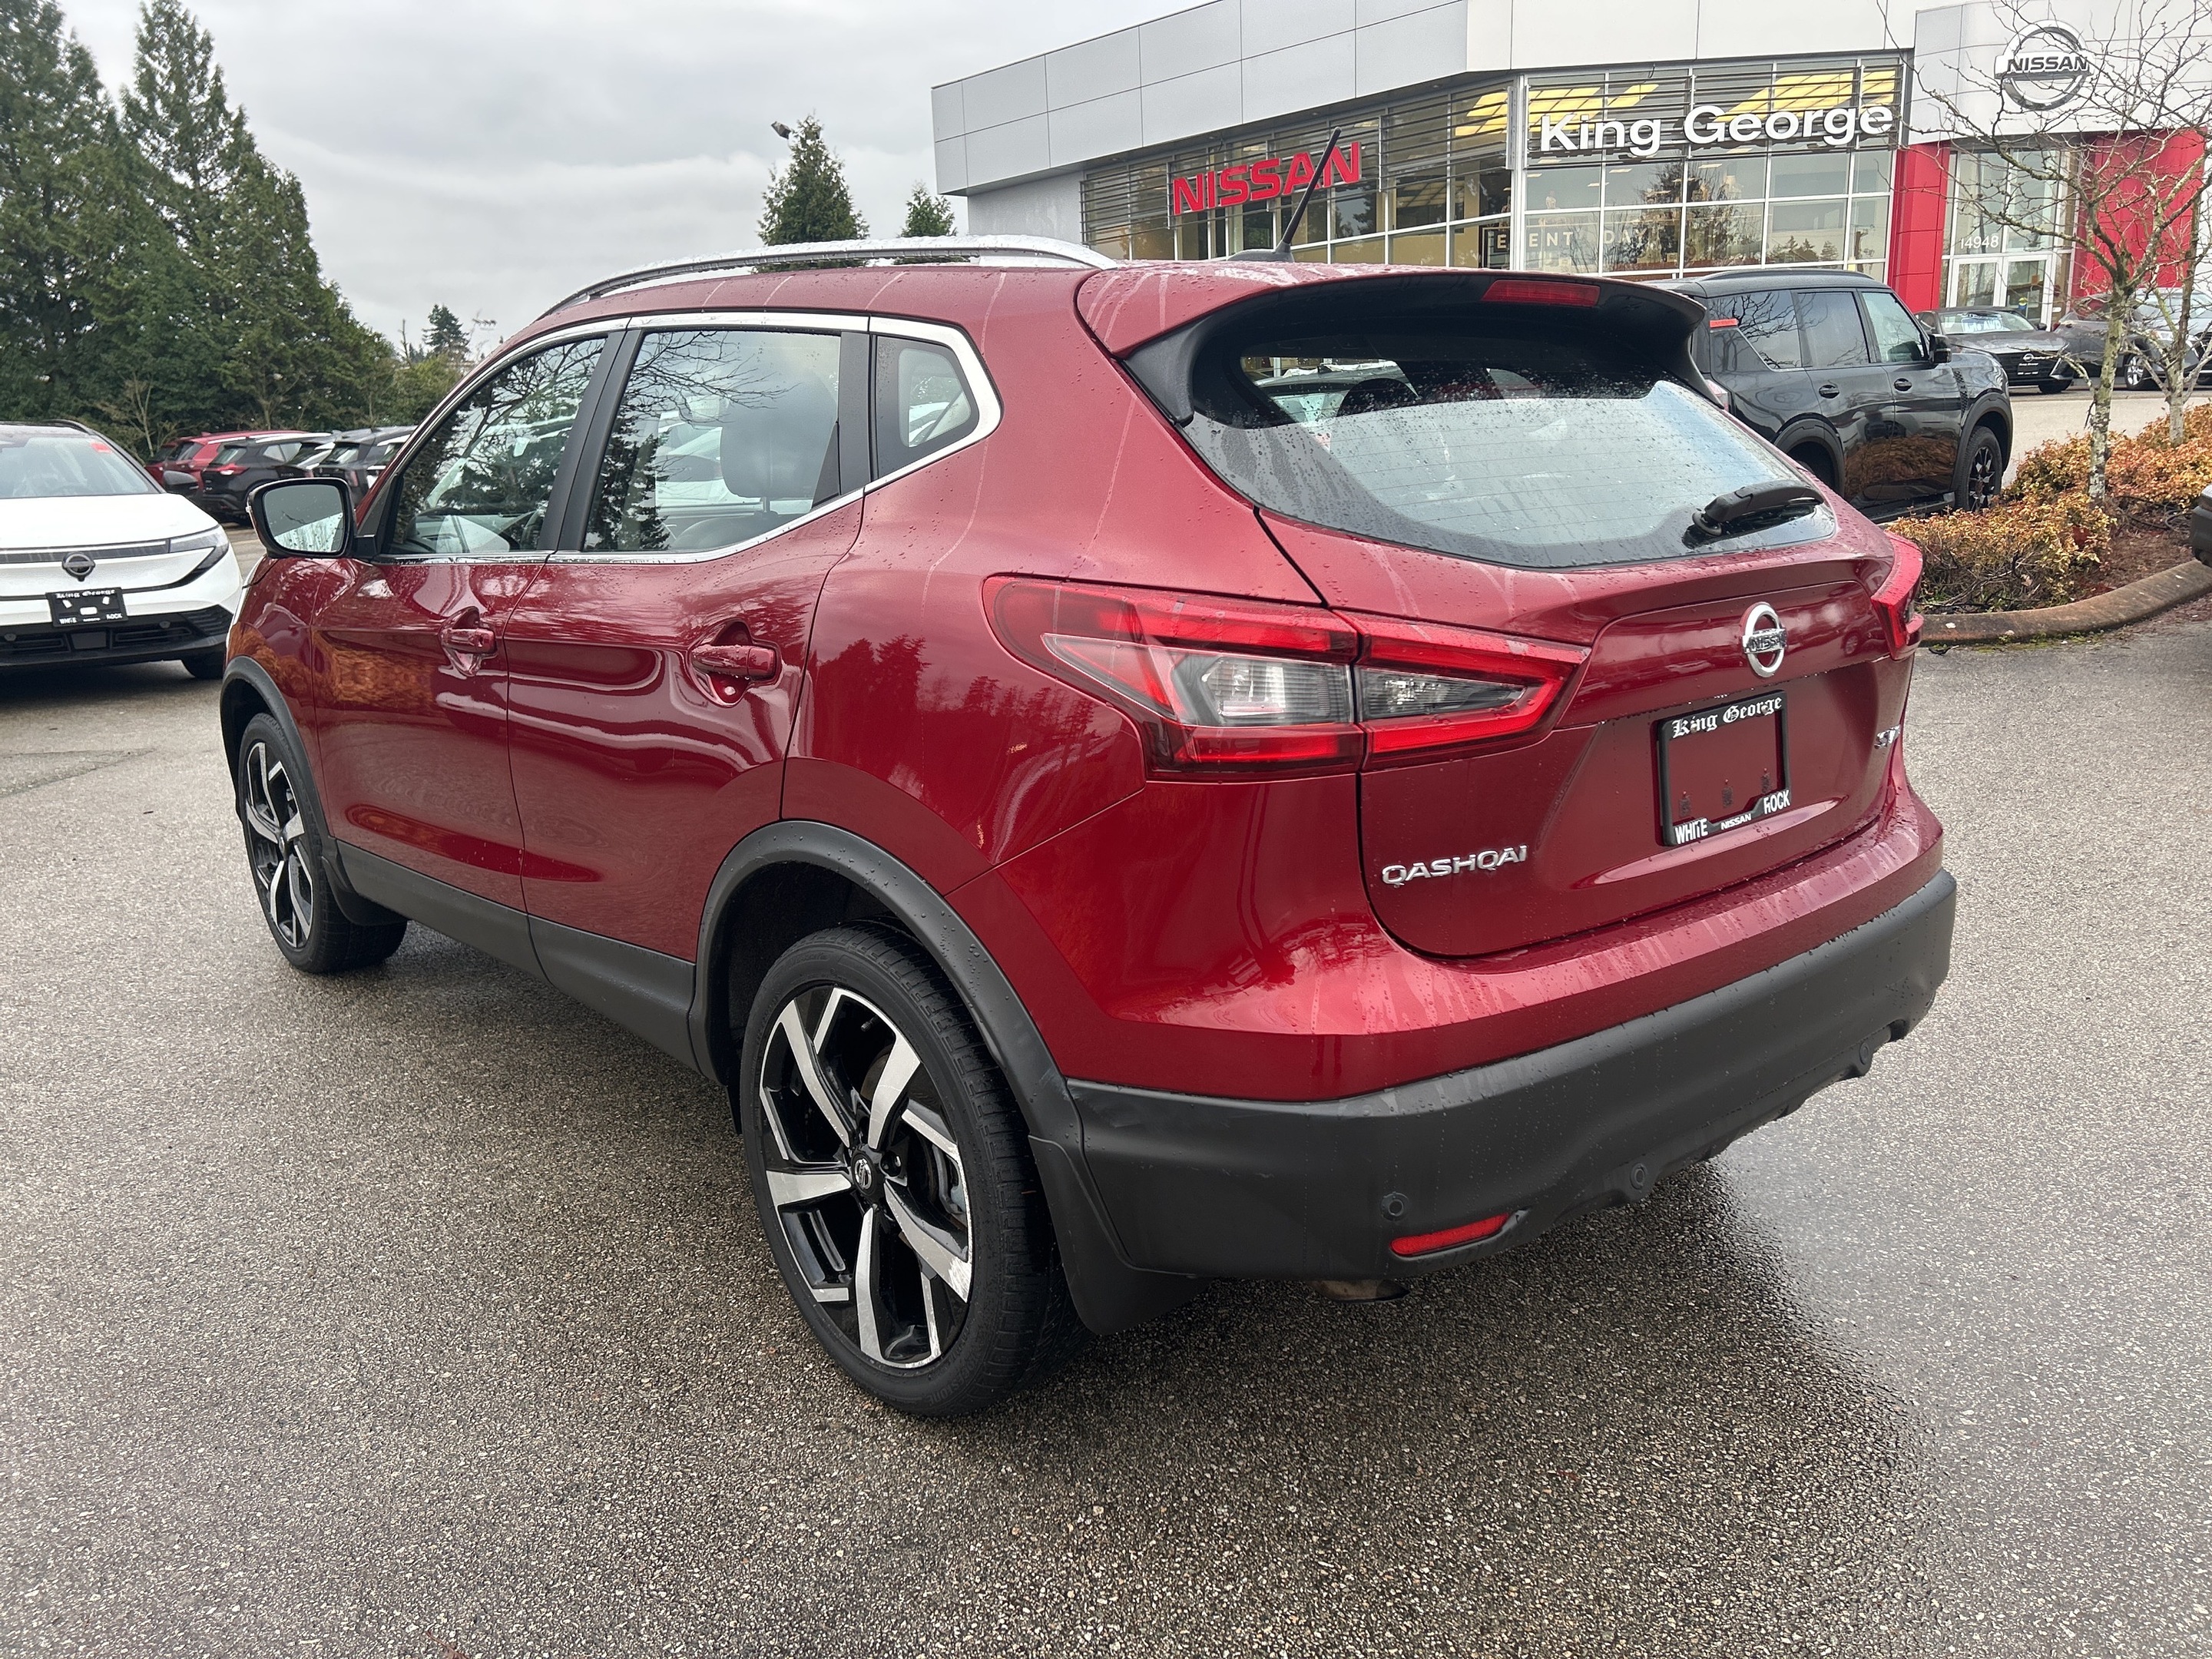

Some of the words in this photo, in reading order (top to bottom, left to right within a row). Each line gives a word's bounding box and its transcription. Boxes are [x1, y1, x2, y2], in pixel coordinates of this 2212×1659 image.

[2007, 56, 2088, 74] NISSAN
[1540, 113, 1661, 157] King
[1684, 105, 1893, 145] George
[1173, 141, 1362, 216] NISSAN
[1497, 231, 1574, 249] EENT
[1959, 235, 1999, 250] 14948
[1671, 714, 1718, 738] King
[1723, 697, 1783, 724] George
[1763, 790, 1790, 814] ROCK
[1674, 818, 1708, 845] WHITE
[1720, 813, 1751, 830] NISSAN
[1382, 845, 1528, 886] QASHQAI
